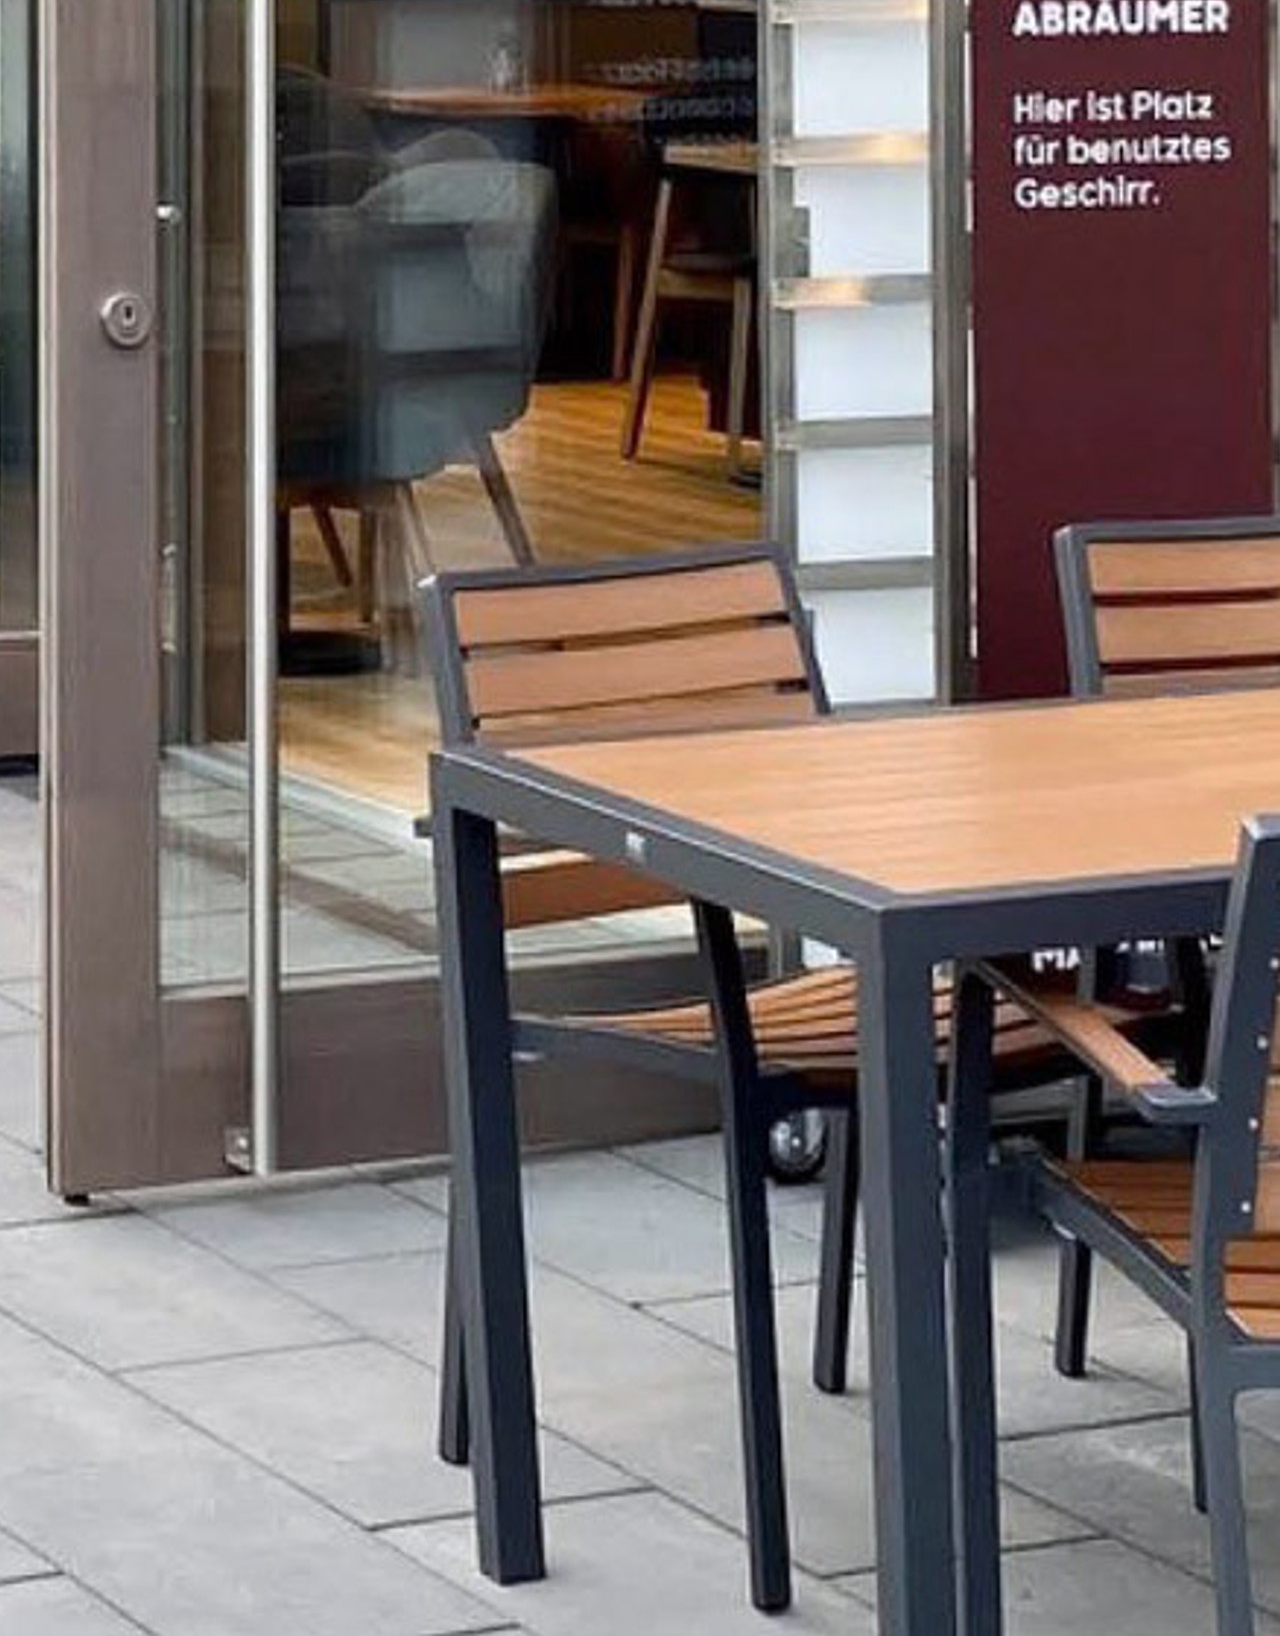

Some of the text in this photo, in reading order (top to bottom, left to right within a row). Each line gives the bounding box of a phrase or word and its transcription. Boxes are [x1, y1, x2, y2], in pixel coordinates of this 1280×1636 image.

[1014, 90, 1213, 123] Hier ist Platz
[1014, 132, 1231, 166] für benutztes
[1014, 175, 1160, 209] Geschirr.
